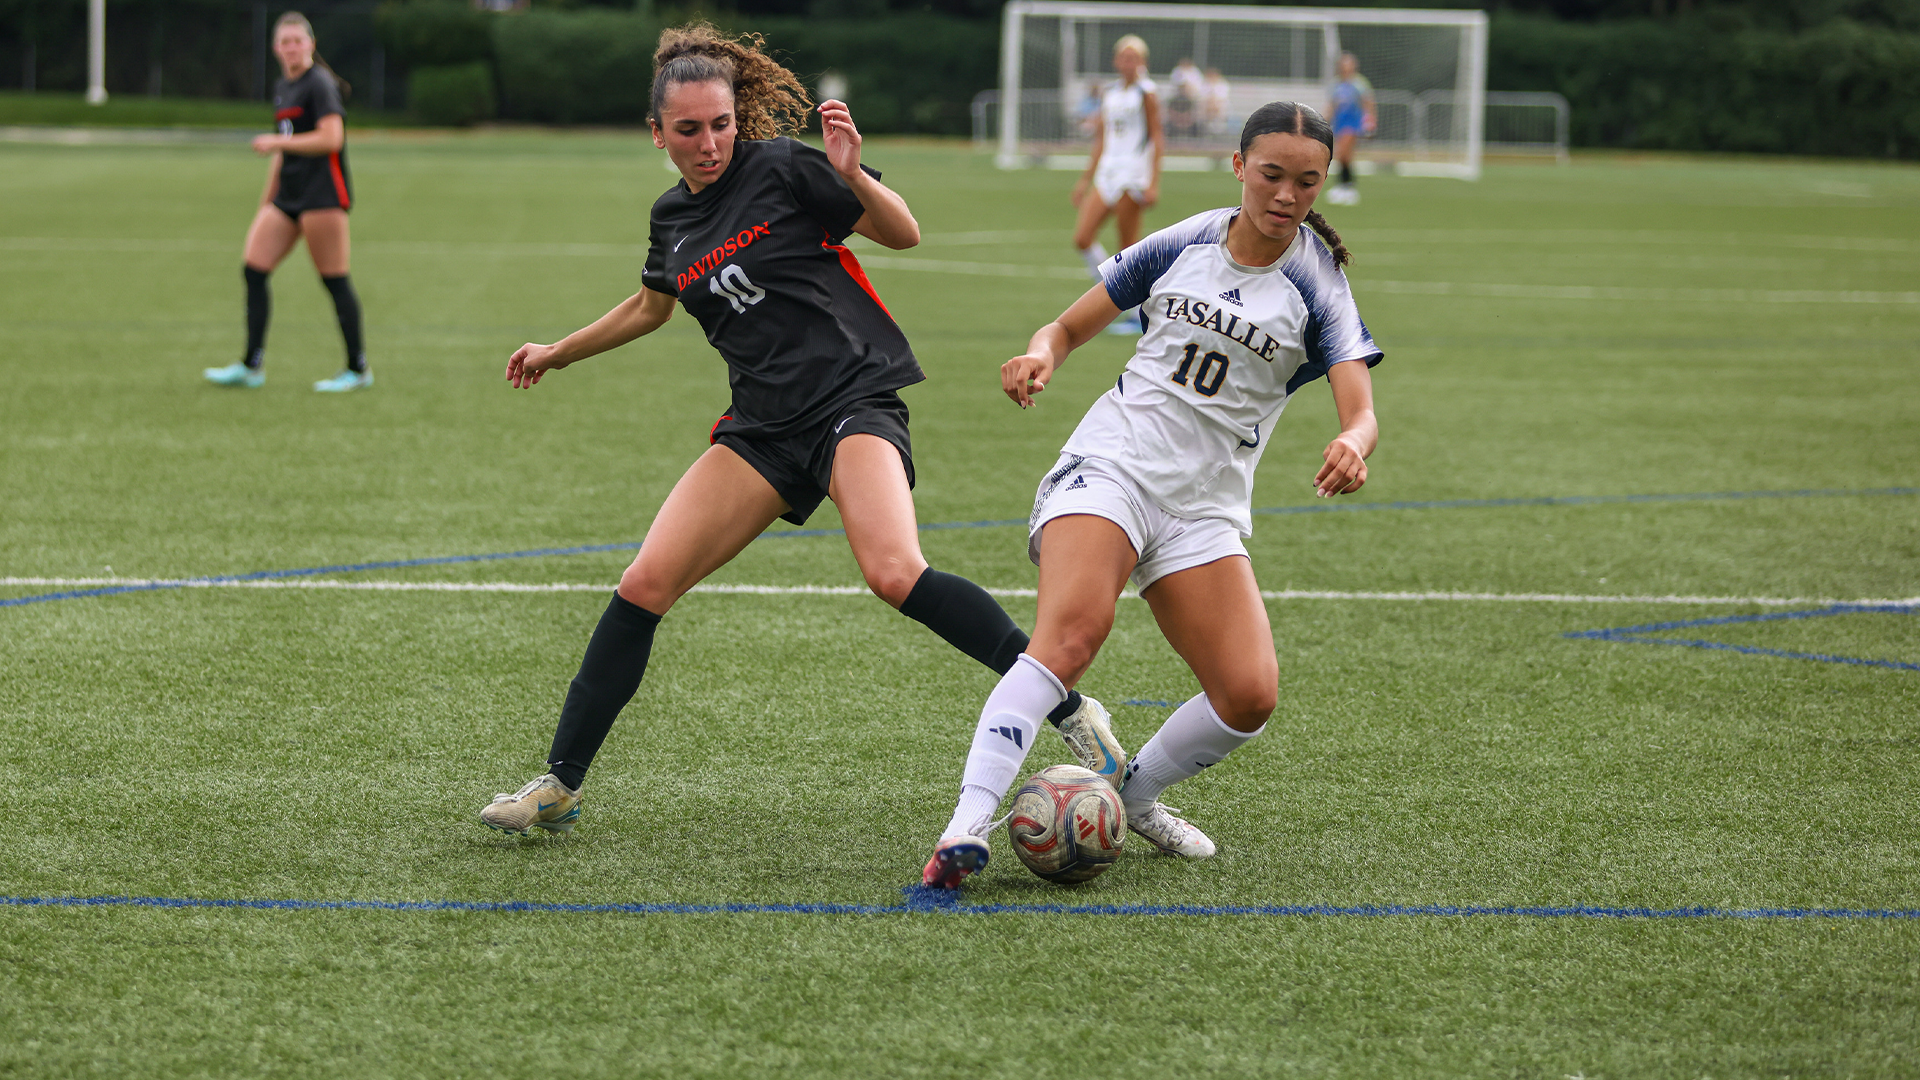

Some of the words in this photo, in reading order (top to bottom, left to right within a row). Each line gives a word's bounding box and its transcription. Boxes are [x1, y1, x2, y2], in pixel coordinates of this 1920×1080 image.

[676, 221, 771, 292] DAVIDSON
[709, 263, 766, 315] 10
[1218, 292, 1244, 308] adidas
[1171, 343, 1230, 398] 10
